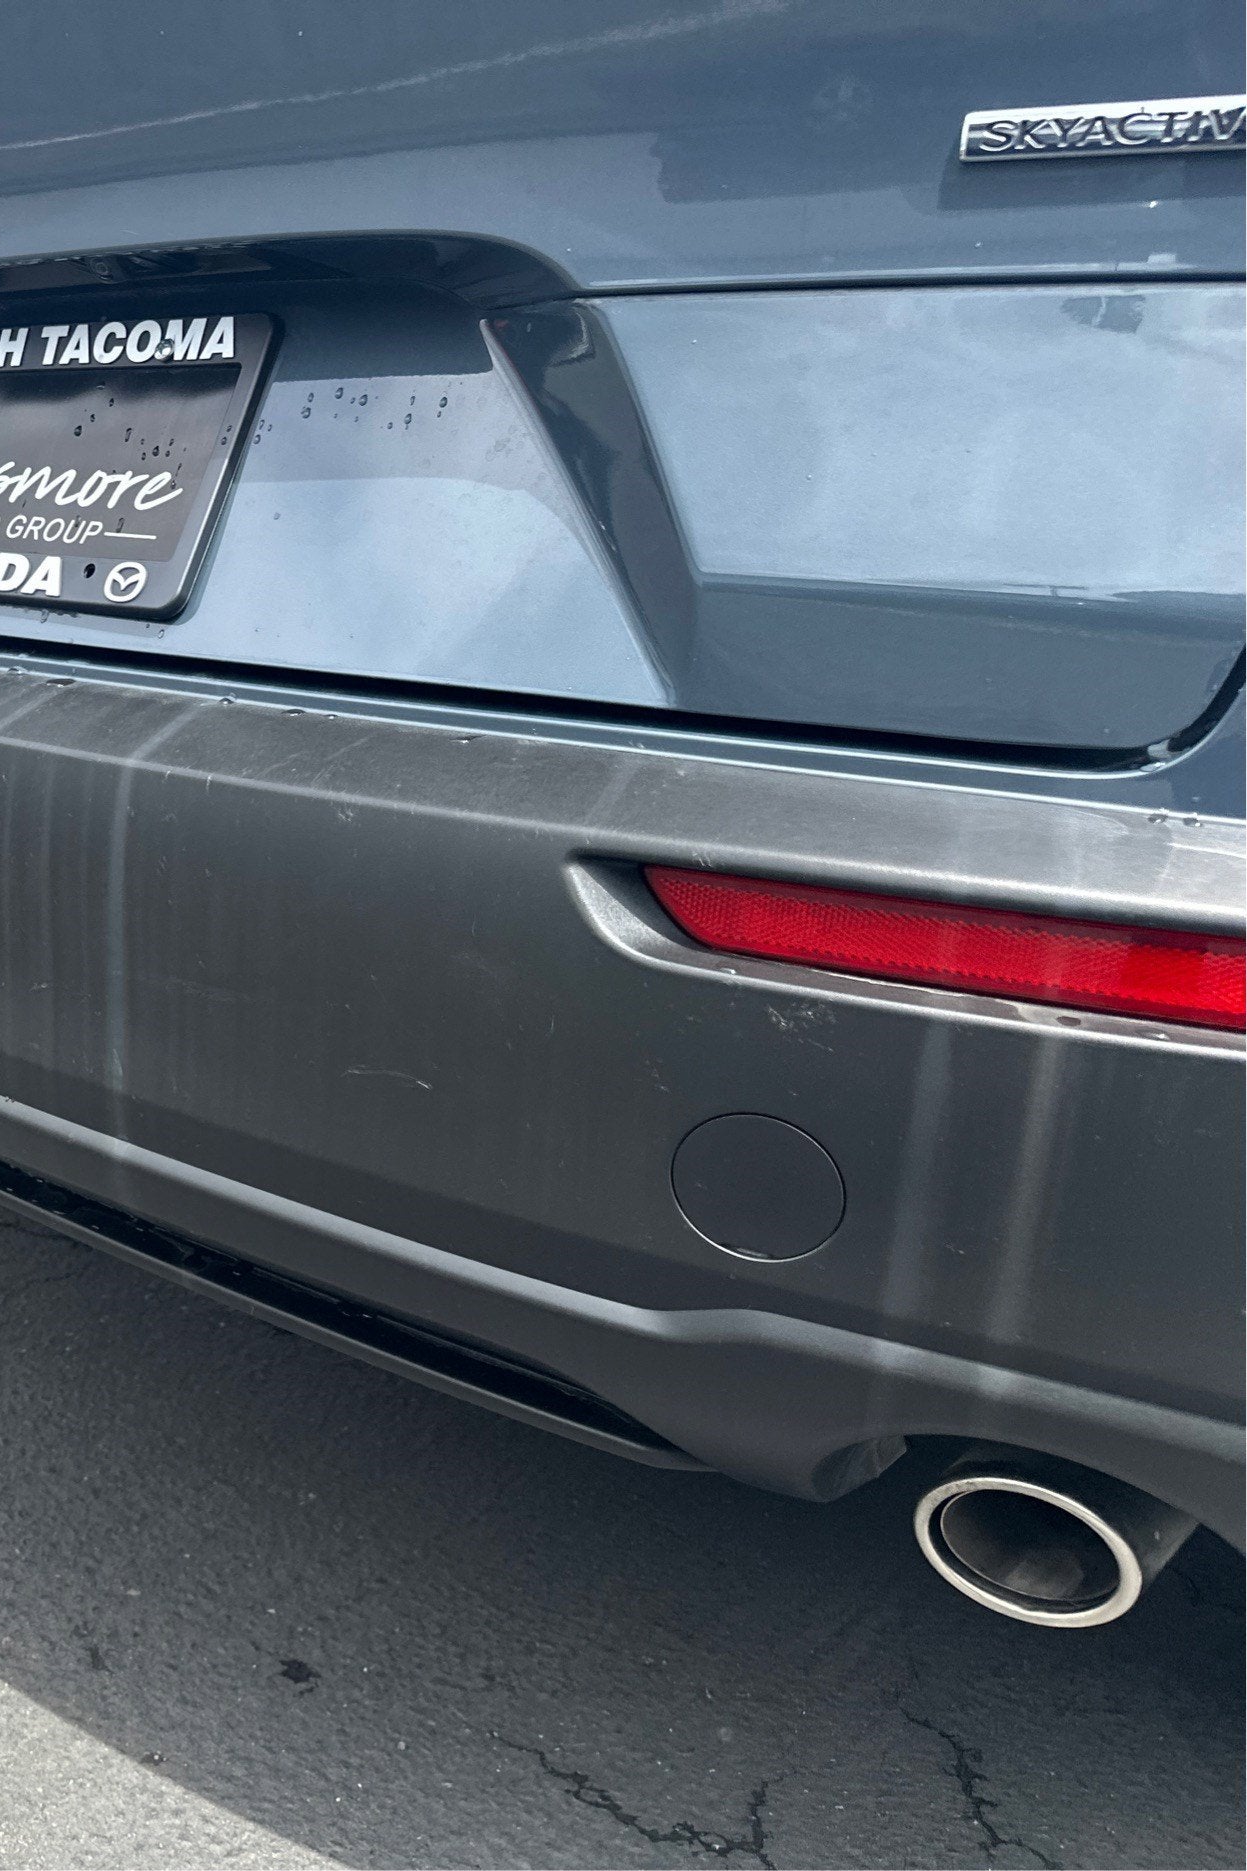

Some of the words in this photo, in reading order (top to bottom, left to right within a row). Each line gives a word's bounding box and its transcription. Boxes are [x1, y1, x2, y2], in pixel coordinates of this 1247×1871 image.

[979, 106, 1247, 151] SKYACTIV
[41, 316, 235, 365] TACOMA
[7, 516, 104, 544] GROUP
